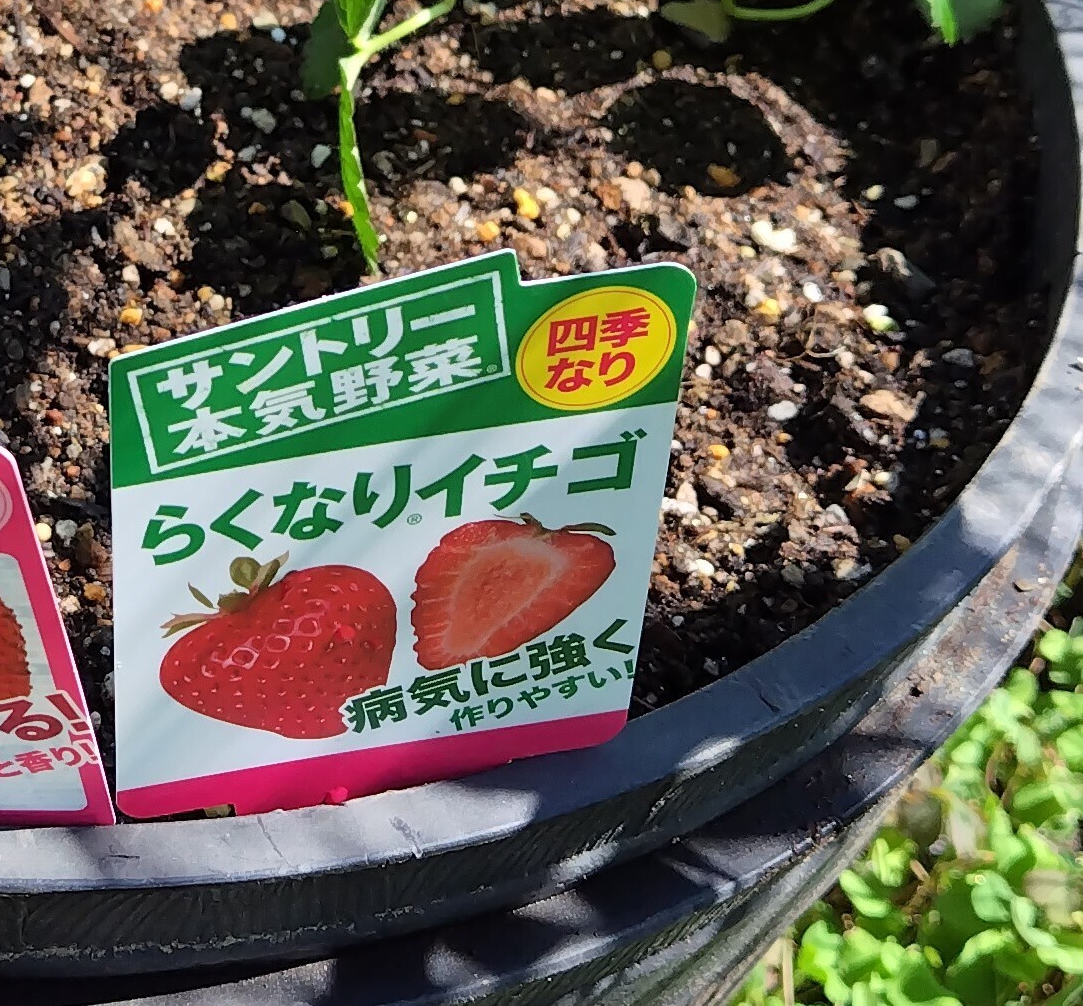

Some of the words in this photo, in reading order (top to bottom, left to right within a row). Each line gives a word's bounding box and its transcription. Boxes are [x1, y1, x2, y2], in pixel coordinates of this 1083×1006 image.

[157, 304, 476, 410] サントリー
[544, 351, 636, 392] なり
[547, 307, 651, 357] 四季
[168, 335, 483, 454] 本気野菜
[140, 428, 648, 566] らくなりイチゴ
[344, 618, 635, 734] 病気に強く
